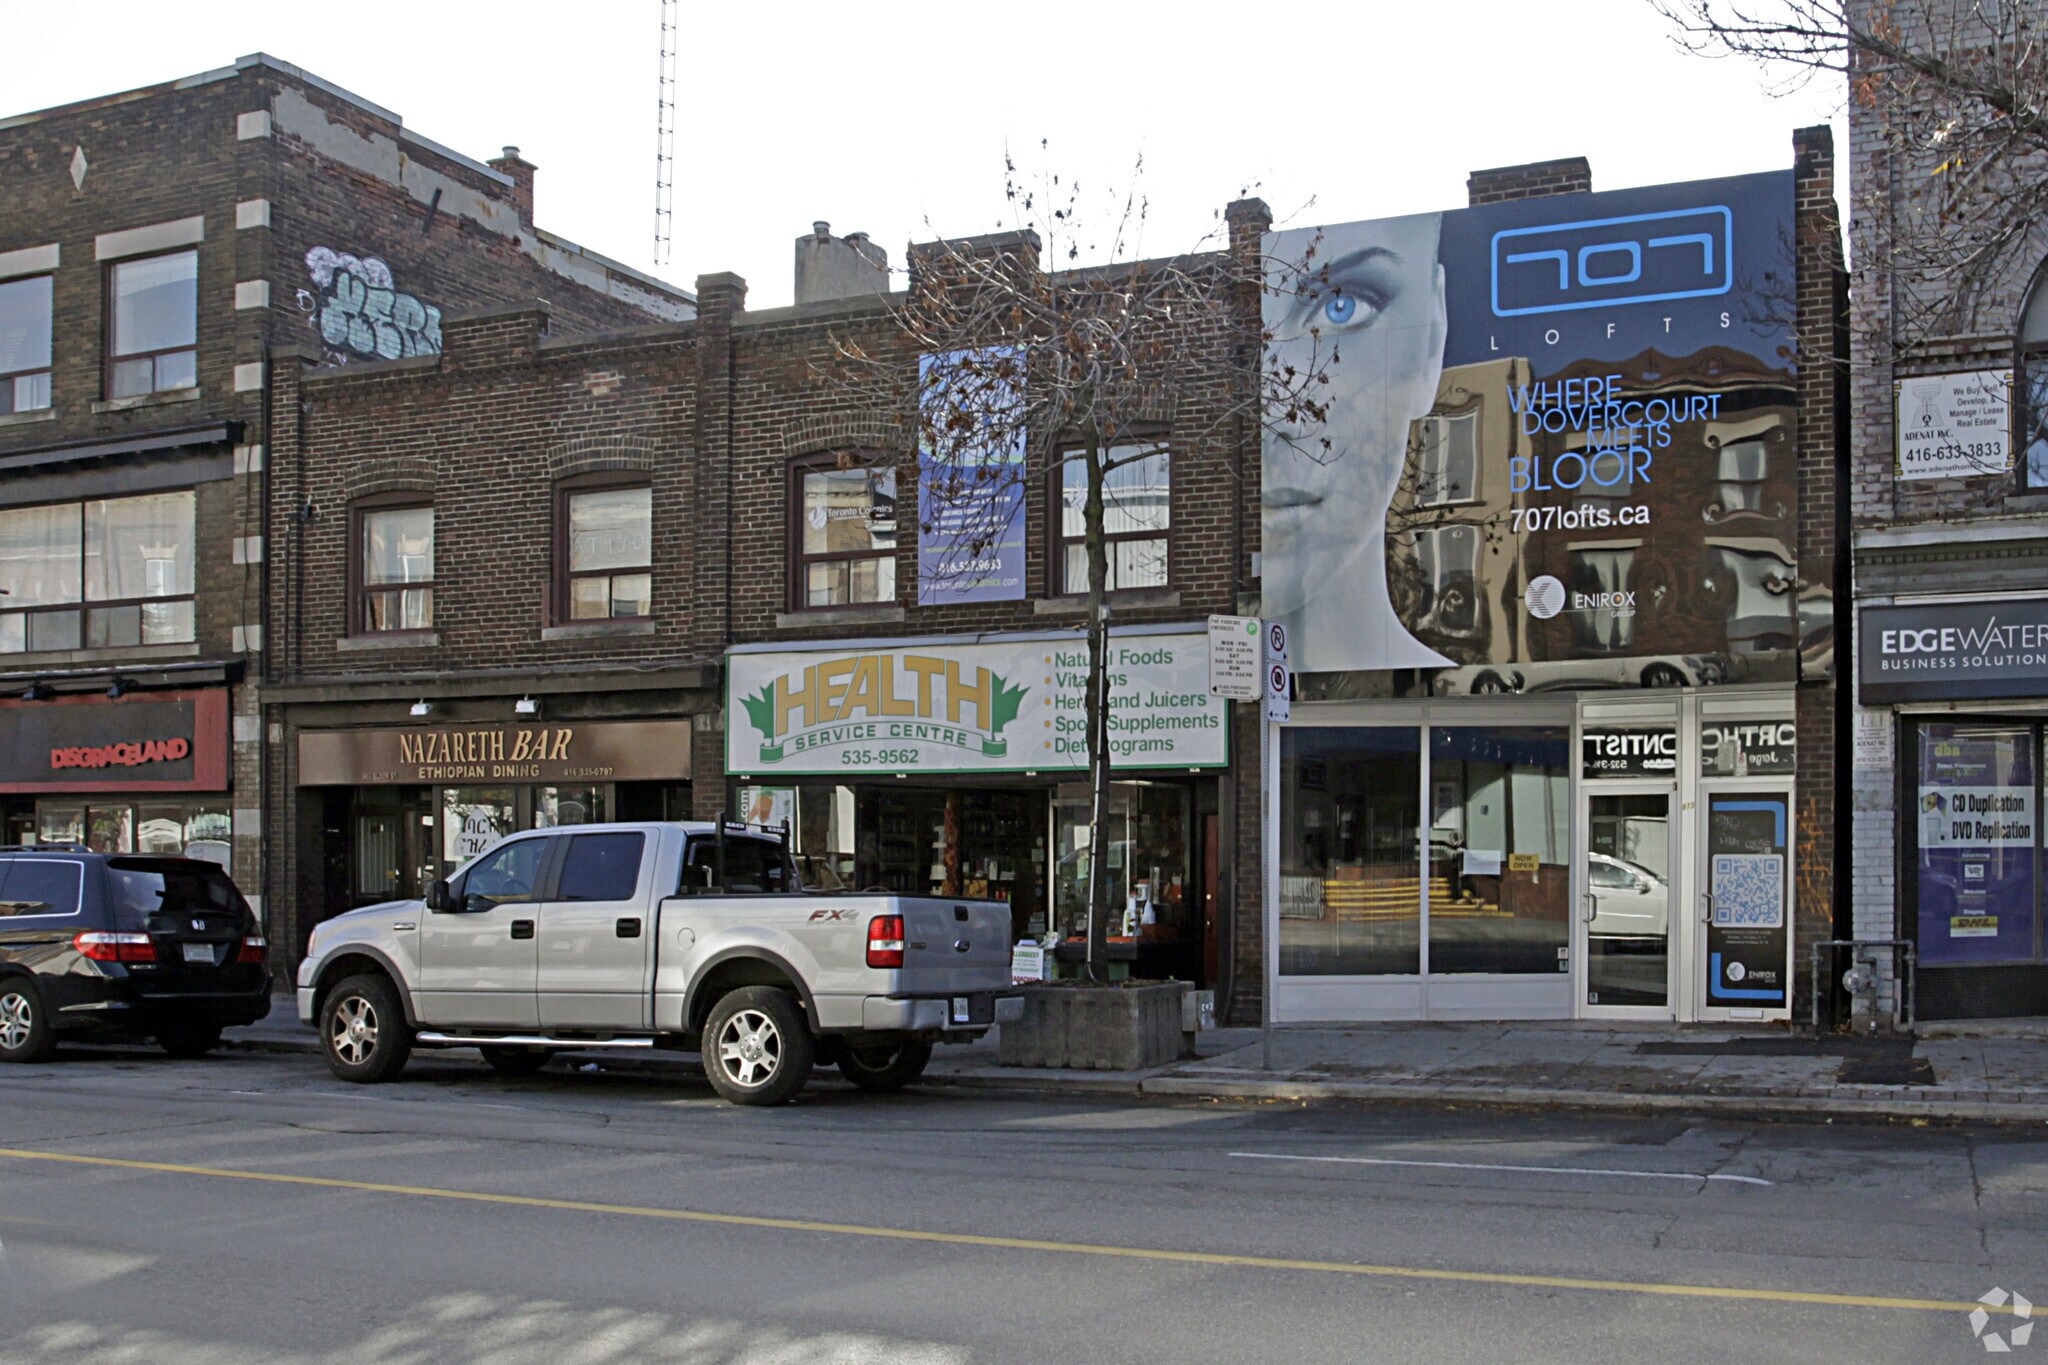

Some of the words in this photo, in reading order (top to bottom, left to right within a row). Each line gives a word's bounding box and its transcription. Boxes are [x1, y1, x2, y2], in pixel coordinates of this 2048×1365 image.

[1506, 232, 1714, 291] 707
[1490, 312, 1731, 351] LOFTS
[1506, 374, 1623, 414] WHERE
[1953, 387, 1965, 395] We
[1522, 394, 1722, 436] DOVERCOURT
[1949, 409, 1977, 418] Manage
[1983, 407, 2004, 415] Lease
[1957, 419, 1973, 427] Real
[1975, 418, 1997, 426] Estate
[1586, 422, 1672, 453] MEETS
[1904, 431, 1934, 441] ADENAT
[1906, 442, 2001, 462] 416-633-3833
[1509, 448, 1653, 493] BLOOR
[828, 508, 857, 517] Toronto
[1510, 504, 1651, 533] 707lofts.ca
[1574, 591, 1636, 609] ENIROX
[1881, 616, 2048, 656] EDGEWATER
[1119, 650, 1173, 665] Foods
[1881, 657, 1956, 670] BUSINESS
[776, 654, 991, 737] HEALTH
[1109, 692, 1140, 708] and
[1145, 691, 1207, 708] Juicers
[1107, 714, 1219, 734] Supplements
[400, 731, 505, 764] NAZARETH
[509, 728, 573, 761] BAR
[795, 724, 877, 751] SERVICE
[889, 723, 967, 746] CENTRE
[51, 737, 189, 769] DISGRACELAND
[841, 748, 919, 764] 535-9562
[418, 765, 485, 779] ETHIOPIAN
[492, 765, 540, 778] DINING
[563, 768, 577, 776] 416
[1952, 794, 1966, 813] CD
[1968, 793, 2025, 816] Duplication
[1952, 821, 1972, 840] DVD
[1975, 821, 2031, 843] Replication
[808, 909, 860, 921] FX4
[1957, 918, 1991, 928] DHL
